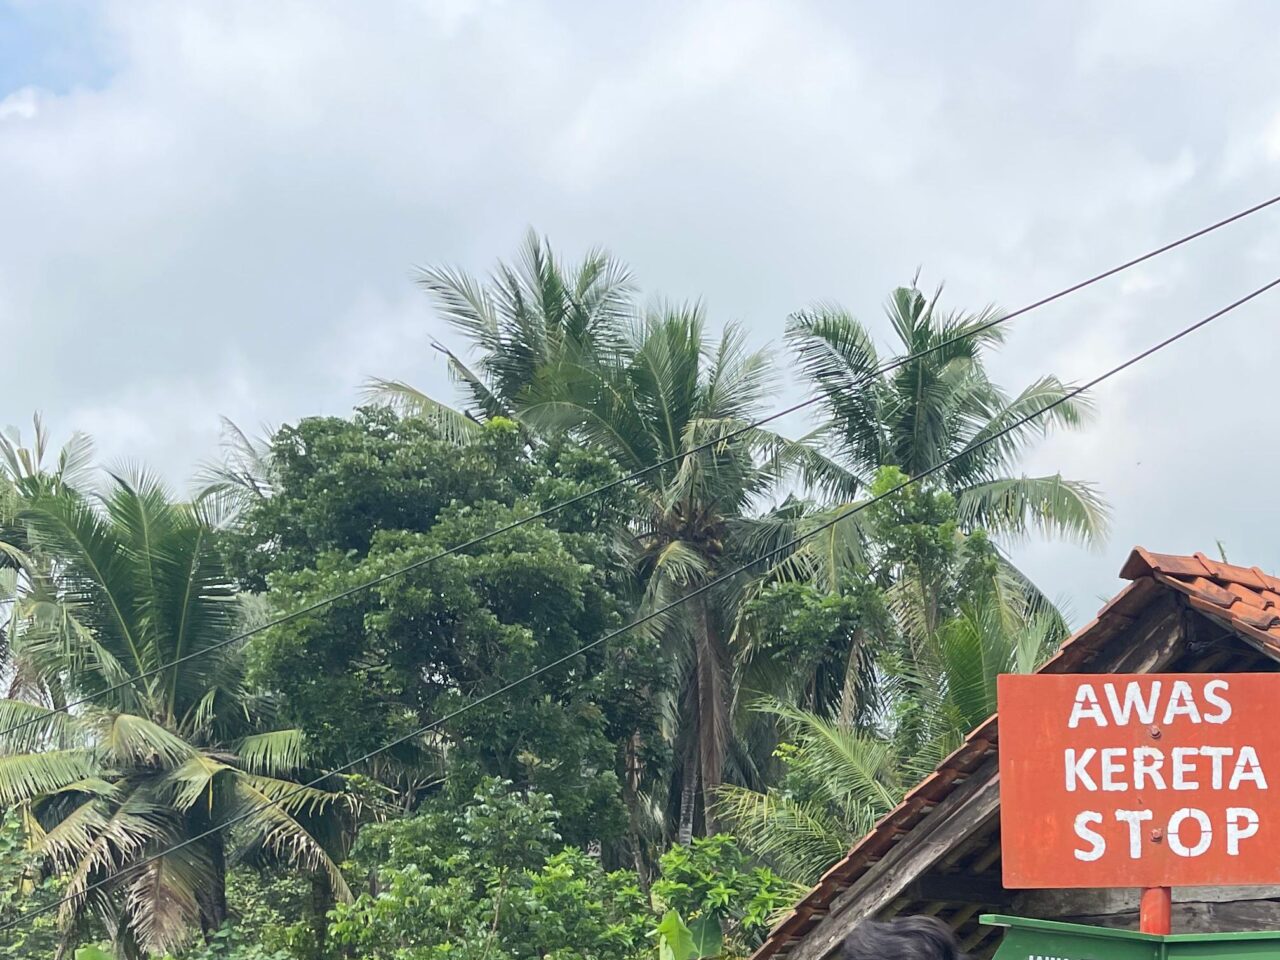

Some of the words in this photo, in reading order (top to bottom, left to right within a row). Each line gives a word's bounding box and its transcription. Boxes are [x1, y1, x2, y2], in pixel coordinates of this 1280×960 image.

[1067, 679, 1232, 729] AWAS
[1064, 746, 1268, 792] KERETA
[1073, 807, 1259, 862] STOP
